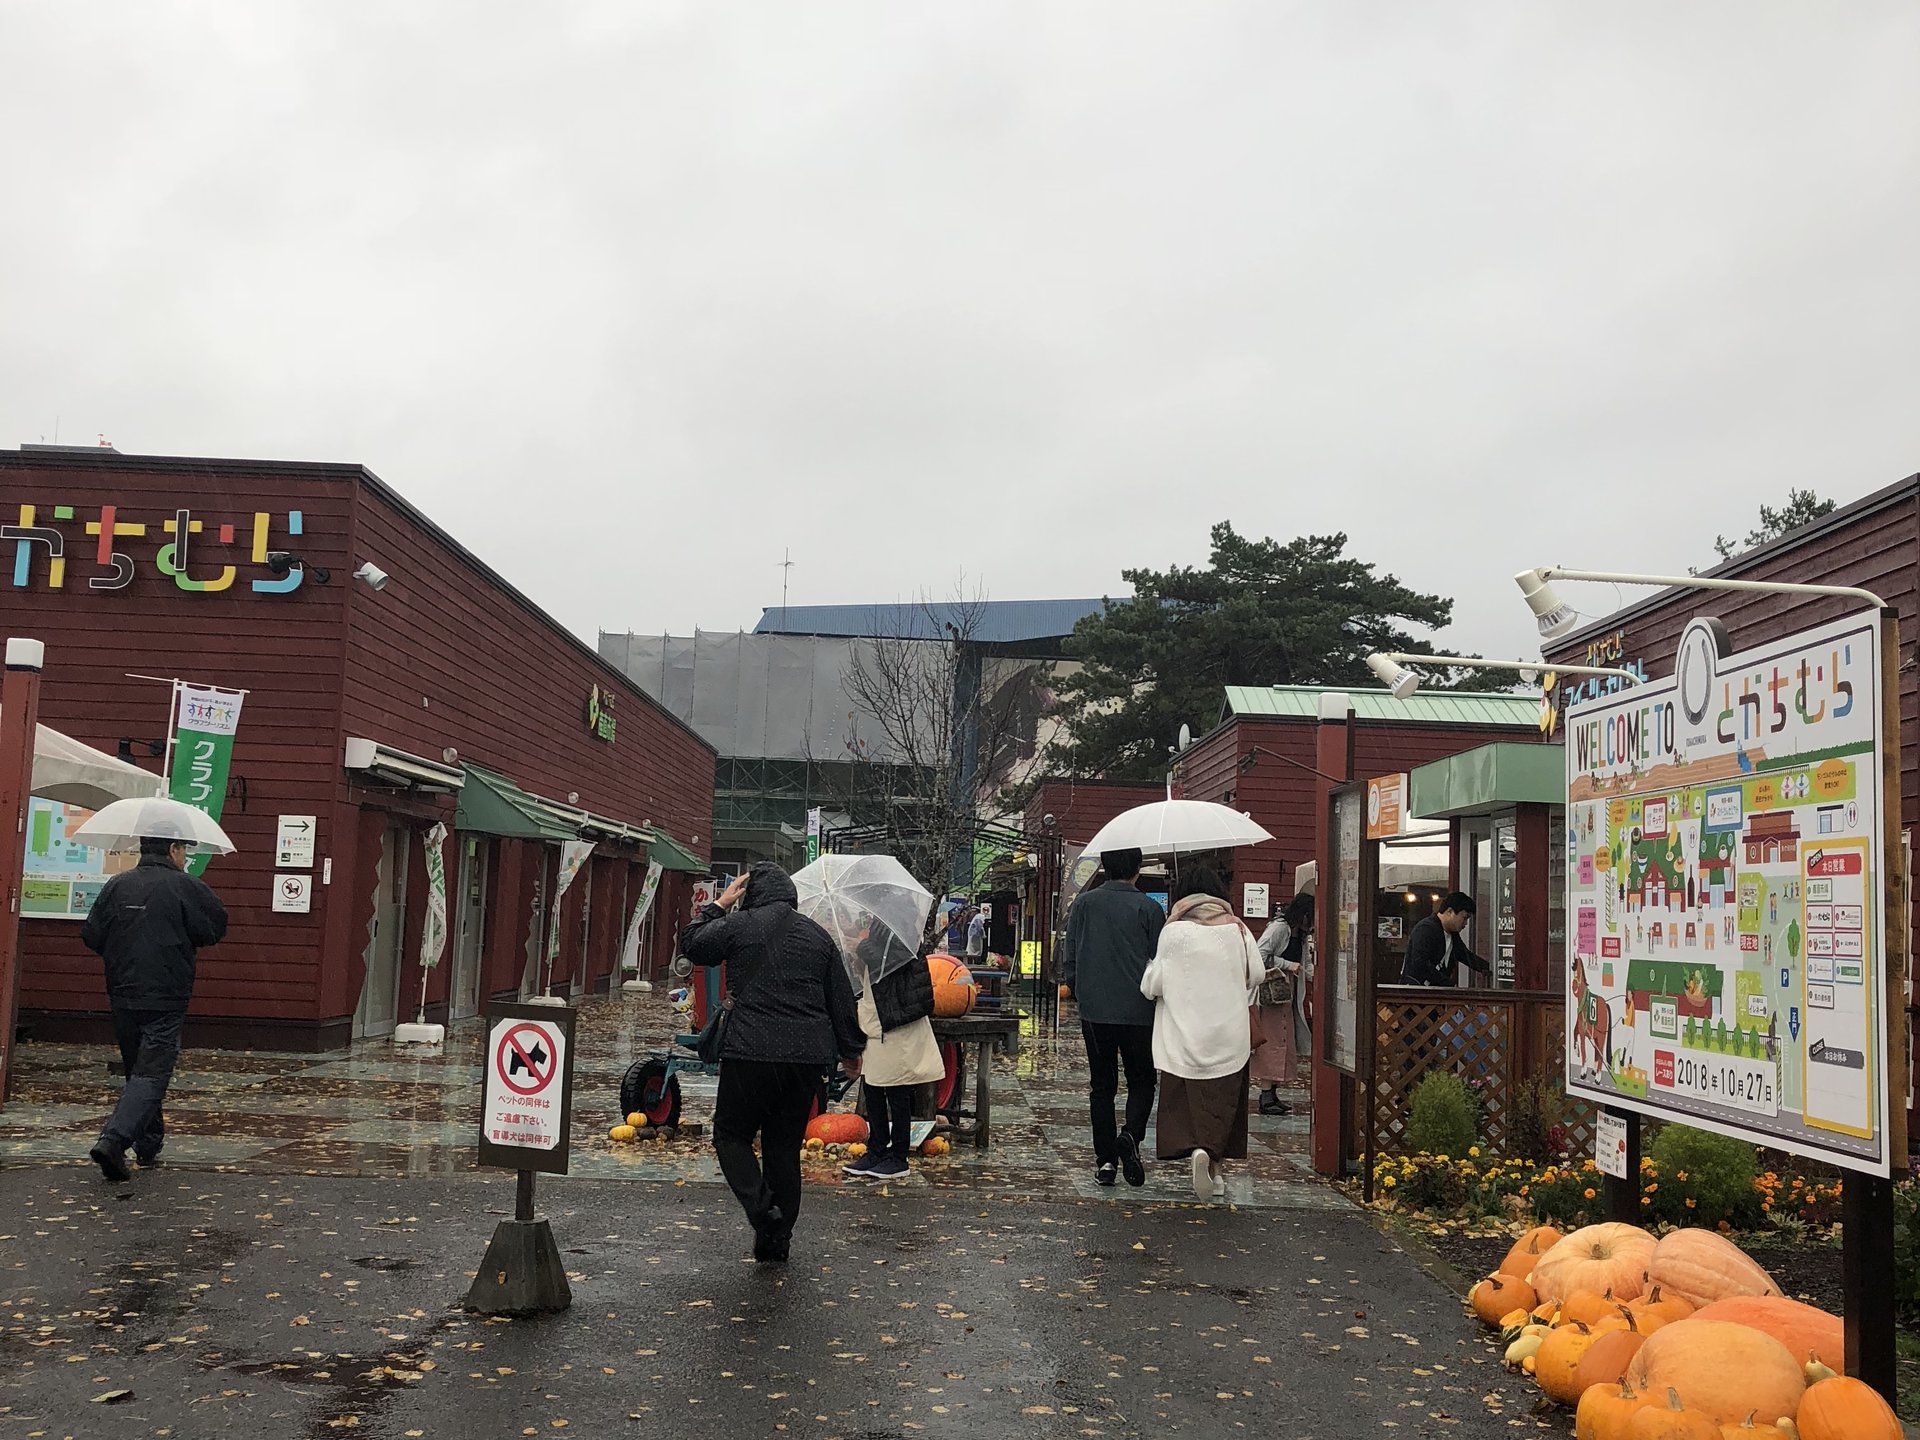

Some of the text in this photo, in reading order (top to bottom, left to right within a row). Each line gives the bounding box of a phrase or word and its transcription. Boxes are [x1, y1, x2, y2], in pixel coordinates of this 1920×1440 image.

[1717, 644, 1853, 744] とかちむら
[1576, 701, 1674, 772] WELCOME TO
[1741, 935, 1758, 950] 現在地
[1783, 971, 1788, 985] P
[1591, 998, 1596, 1019] 6
[1656, 1067, 1674, 1080] レースあり
[498, 1095, 550, 1109] ペットの同伴は
[496, 1112, 548, 1127] ご遠慮下さい。
